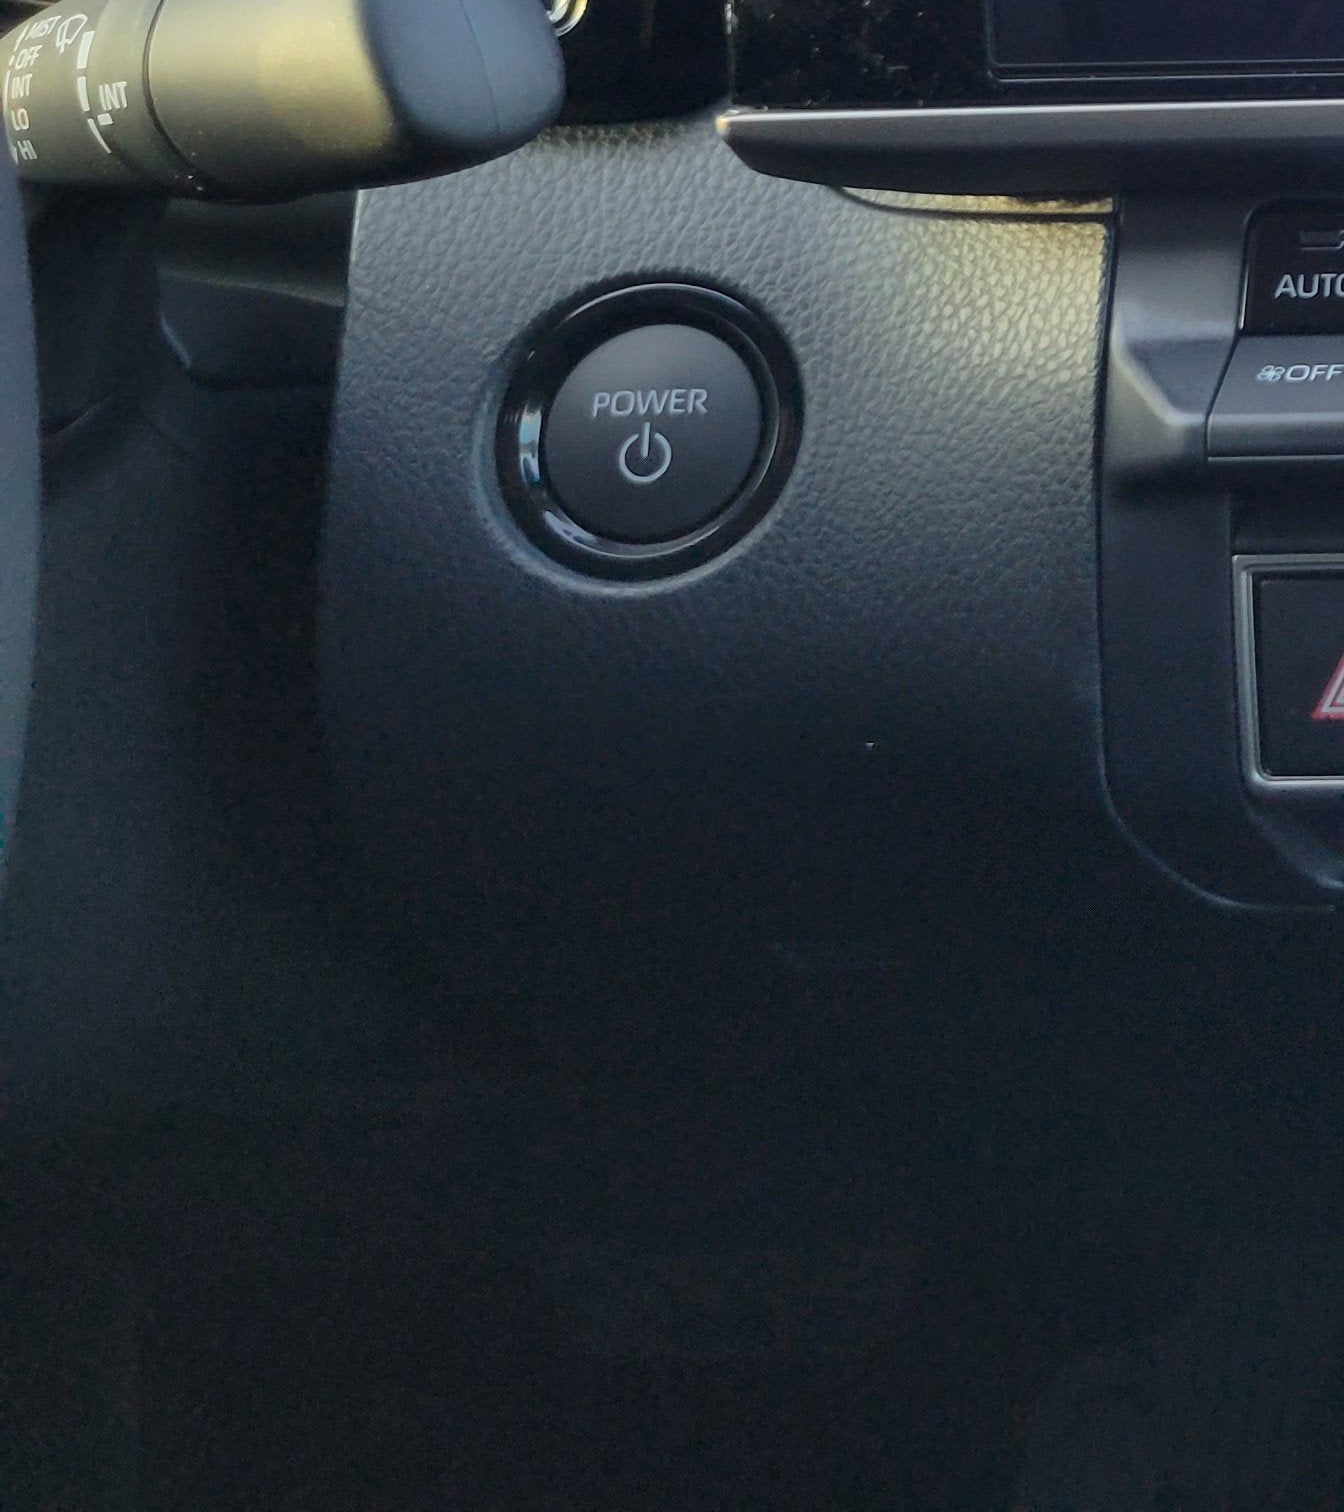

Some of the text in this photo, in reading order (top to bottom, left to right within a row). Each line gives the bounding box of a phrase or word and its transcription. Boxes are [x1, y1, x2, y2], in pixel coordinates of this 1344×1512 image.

[15, 45, 43, 70] OFF
[11, 73, 33, 99] INT
[98, 81, 128, 111] INT
[11, 108, 30, 131] LO
[17, 140, 37, 161] HI
[1284, 362, 1344, 384] OFF
[592, 388, 708, 418] POWER
